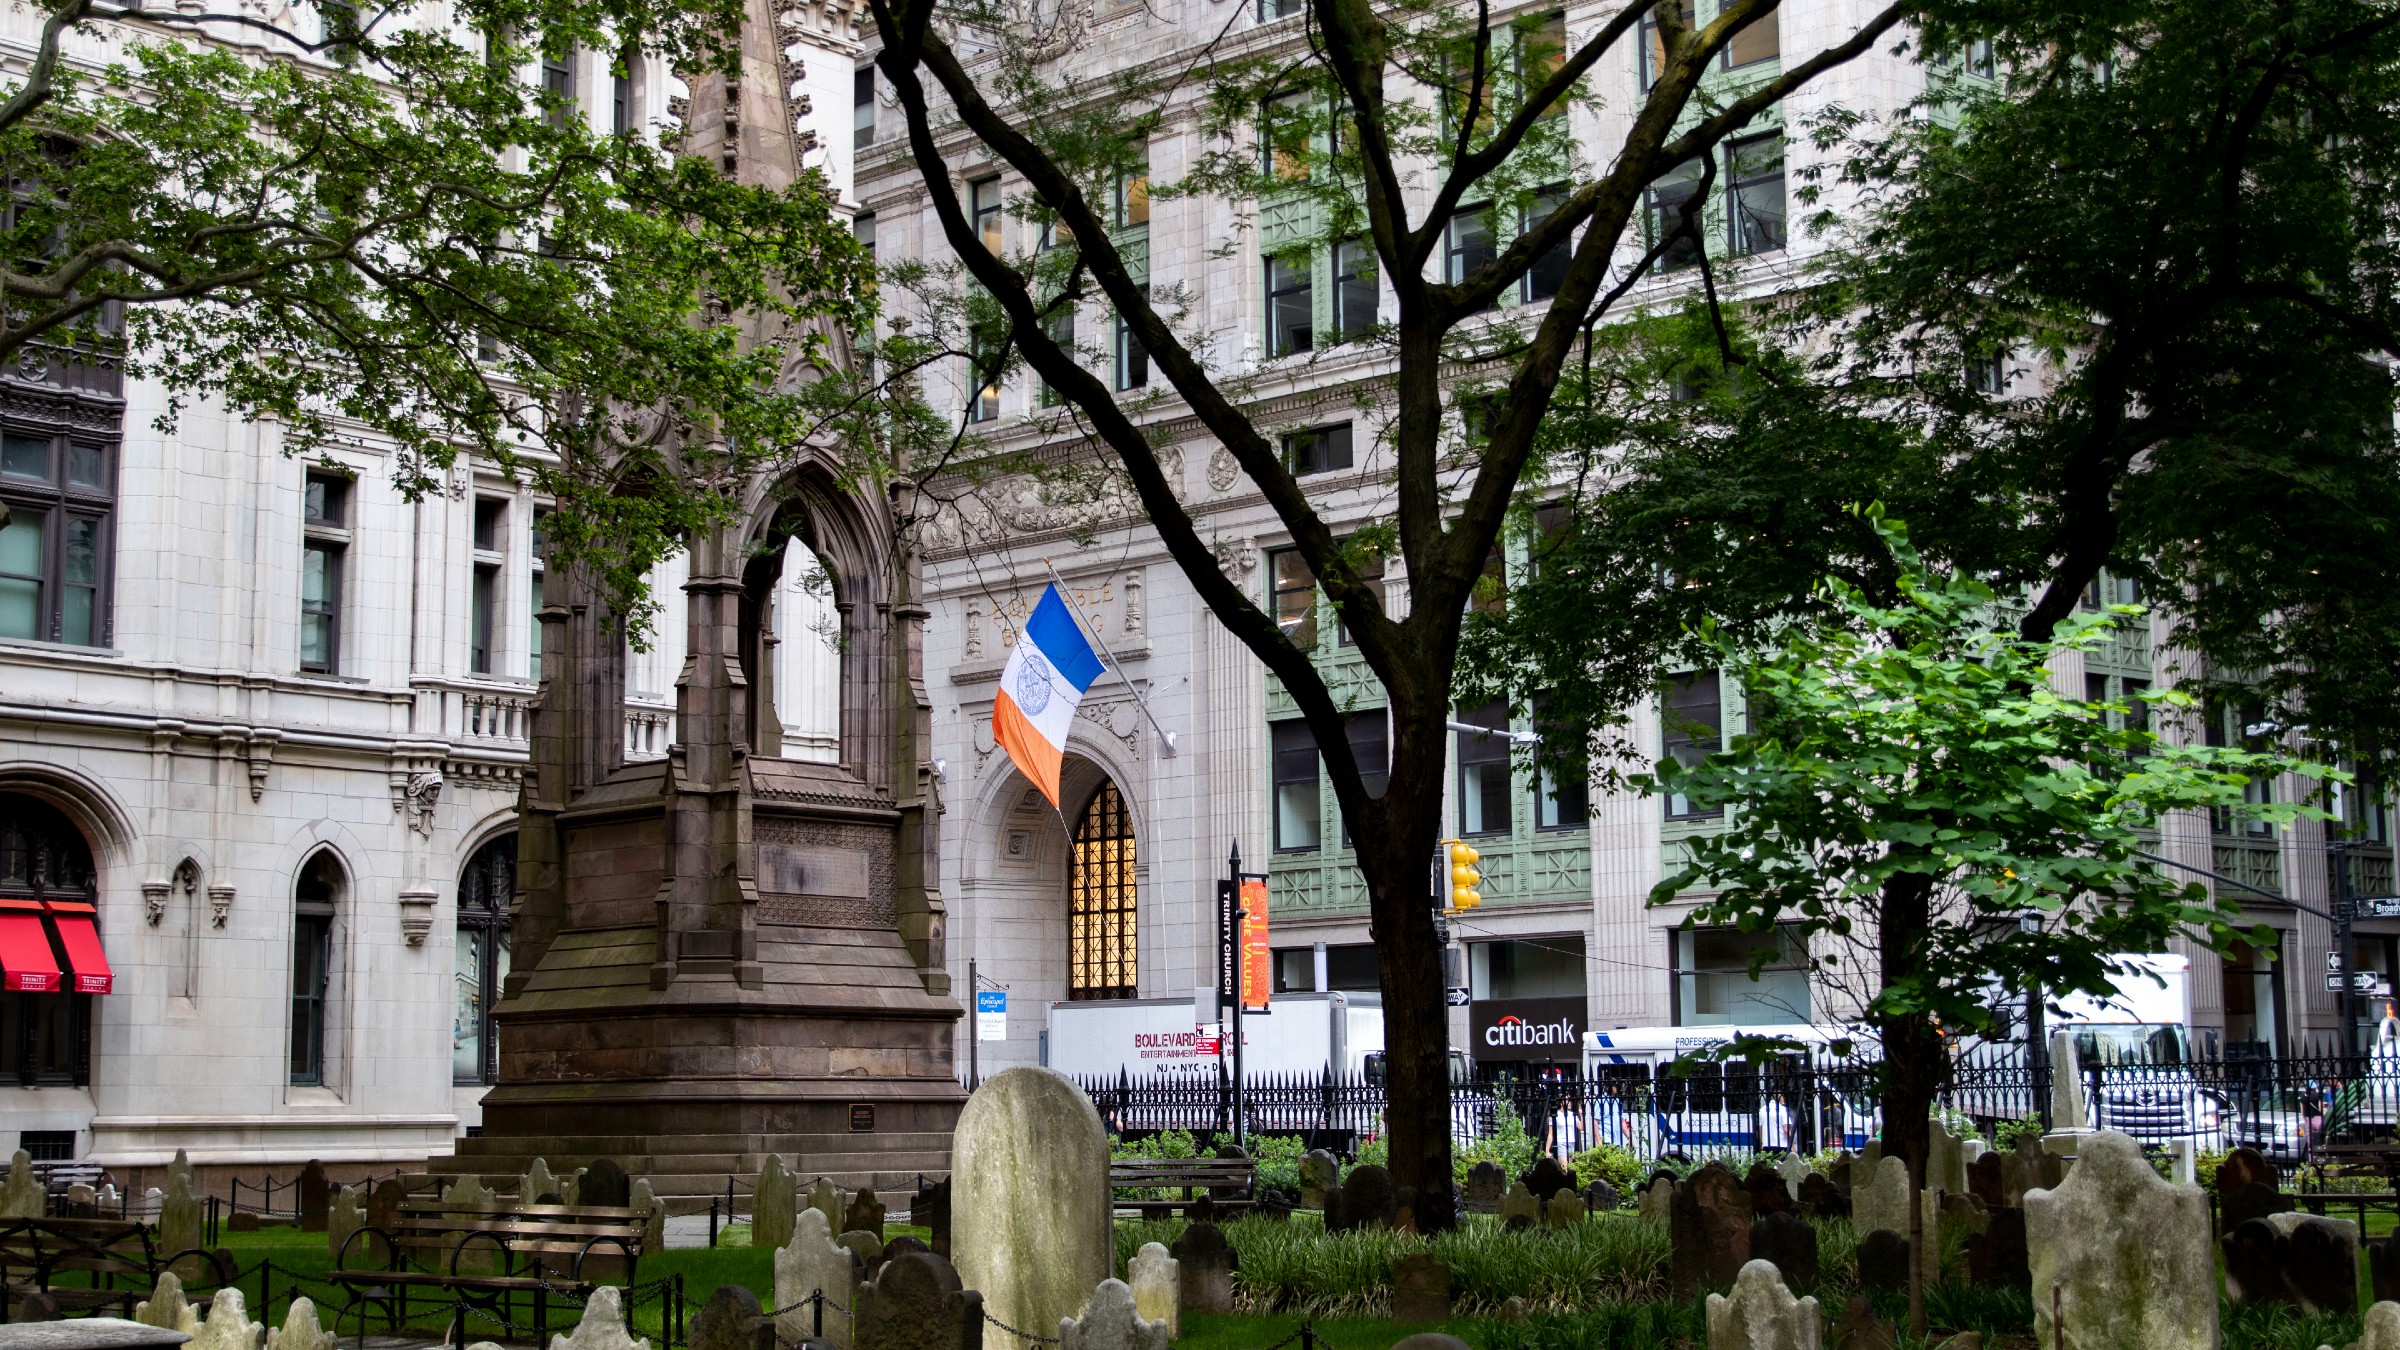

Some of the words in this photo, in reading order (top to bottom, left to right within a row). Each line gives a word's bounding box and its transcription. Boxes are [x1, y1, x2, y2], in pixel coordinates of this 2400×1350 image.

[993, 583, 1113, 619] EQUABLE
[1223, 892, 1231, 942] TRINITY
[1223, 943, 1232, 996] CHURCH
[1243, 942, 1253, 997] VALUES
[1135, 1032, 1196, 1048] BOULEVARD
[1485, 1017, 1576, 1046] citibank
[1140, 1049, 1197, 1059] ENTERTAINMENT
[1156, 1063, 1168, 1073] NJ
[1180, 1063, 1199, 1073] NYC
